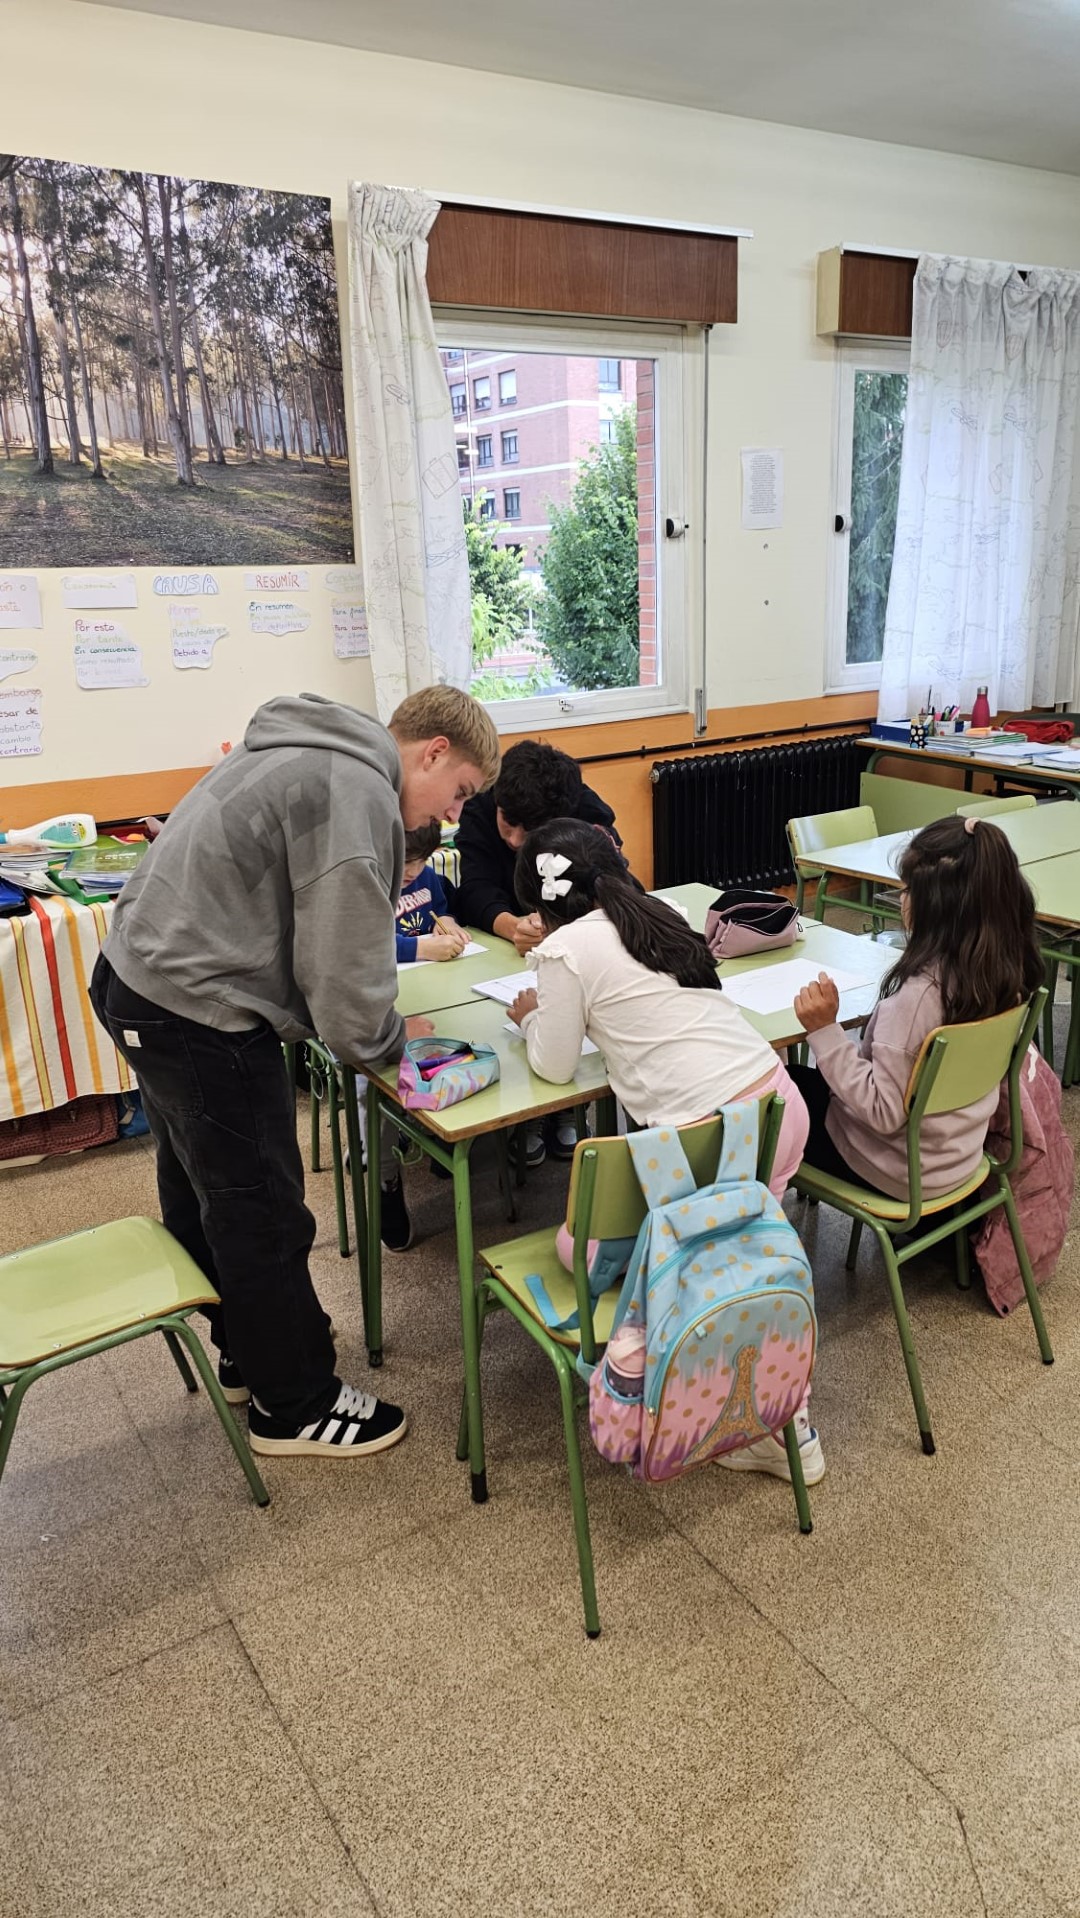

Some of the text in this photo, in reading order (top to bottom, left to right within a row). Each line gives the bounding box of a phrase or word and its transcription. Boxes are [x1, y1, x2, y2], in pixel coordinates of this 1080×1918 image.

[153, 573, 219, 595] CAUSA
[75, 619, 115, 632] Por esto
[174, 648, 199, 657] Debido
[26, 707, 39, 716] de
